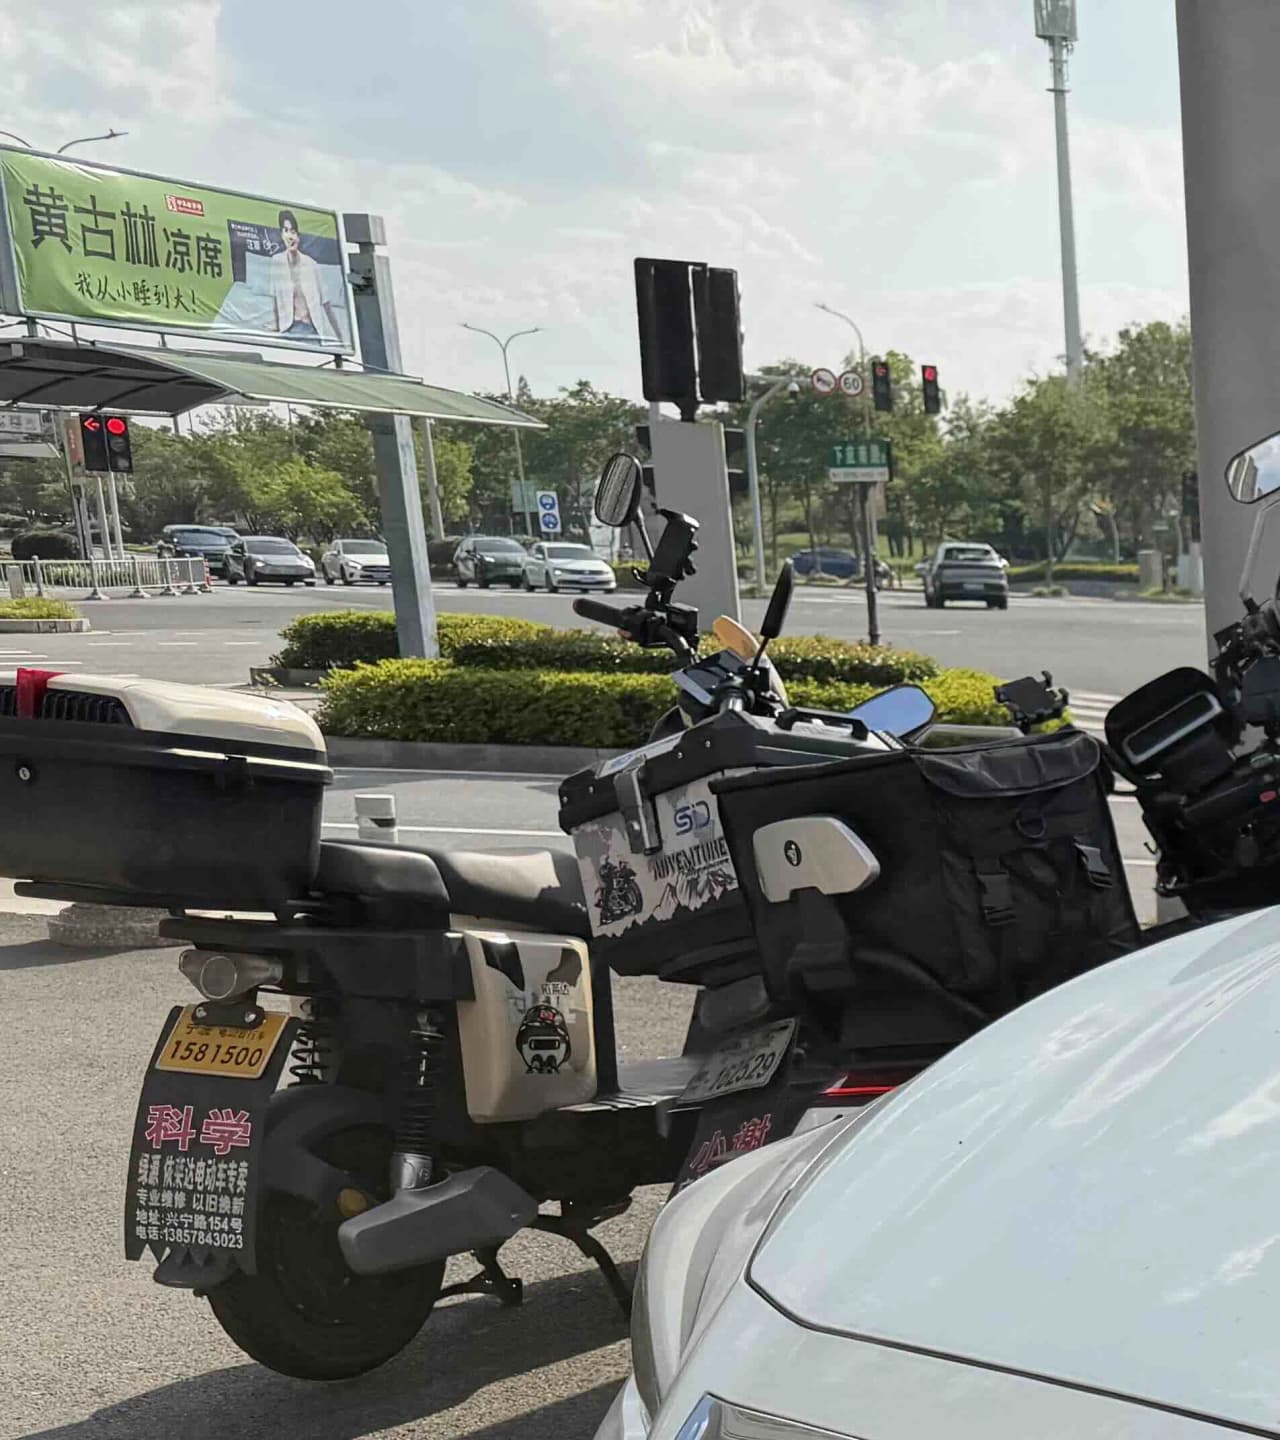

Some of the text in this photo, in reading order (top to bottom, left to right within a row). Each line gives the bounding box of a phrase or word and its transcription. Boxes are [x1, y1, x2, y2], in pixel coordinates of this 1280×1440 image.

[23, 183, 224, 279] 黄古林凉席
[844, 377, 860, 390] 60
[170, 1040, 263, 1067] 1581500
[145, 1104, 252, 1155] 科学
[135, 1188, 245, 1216] 专业维修 以旧换新
